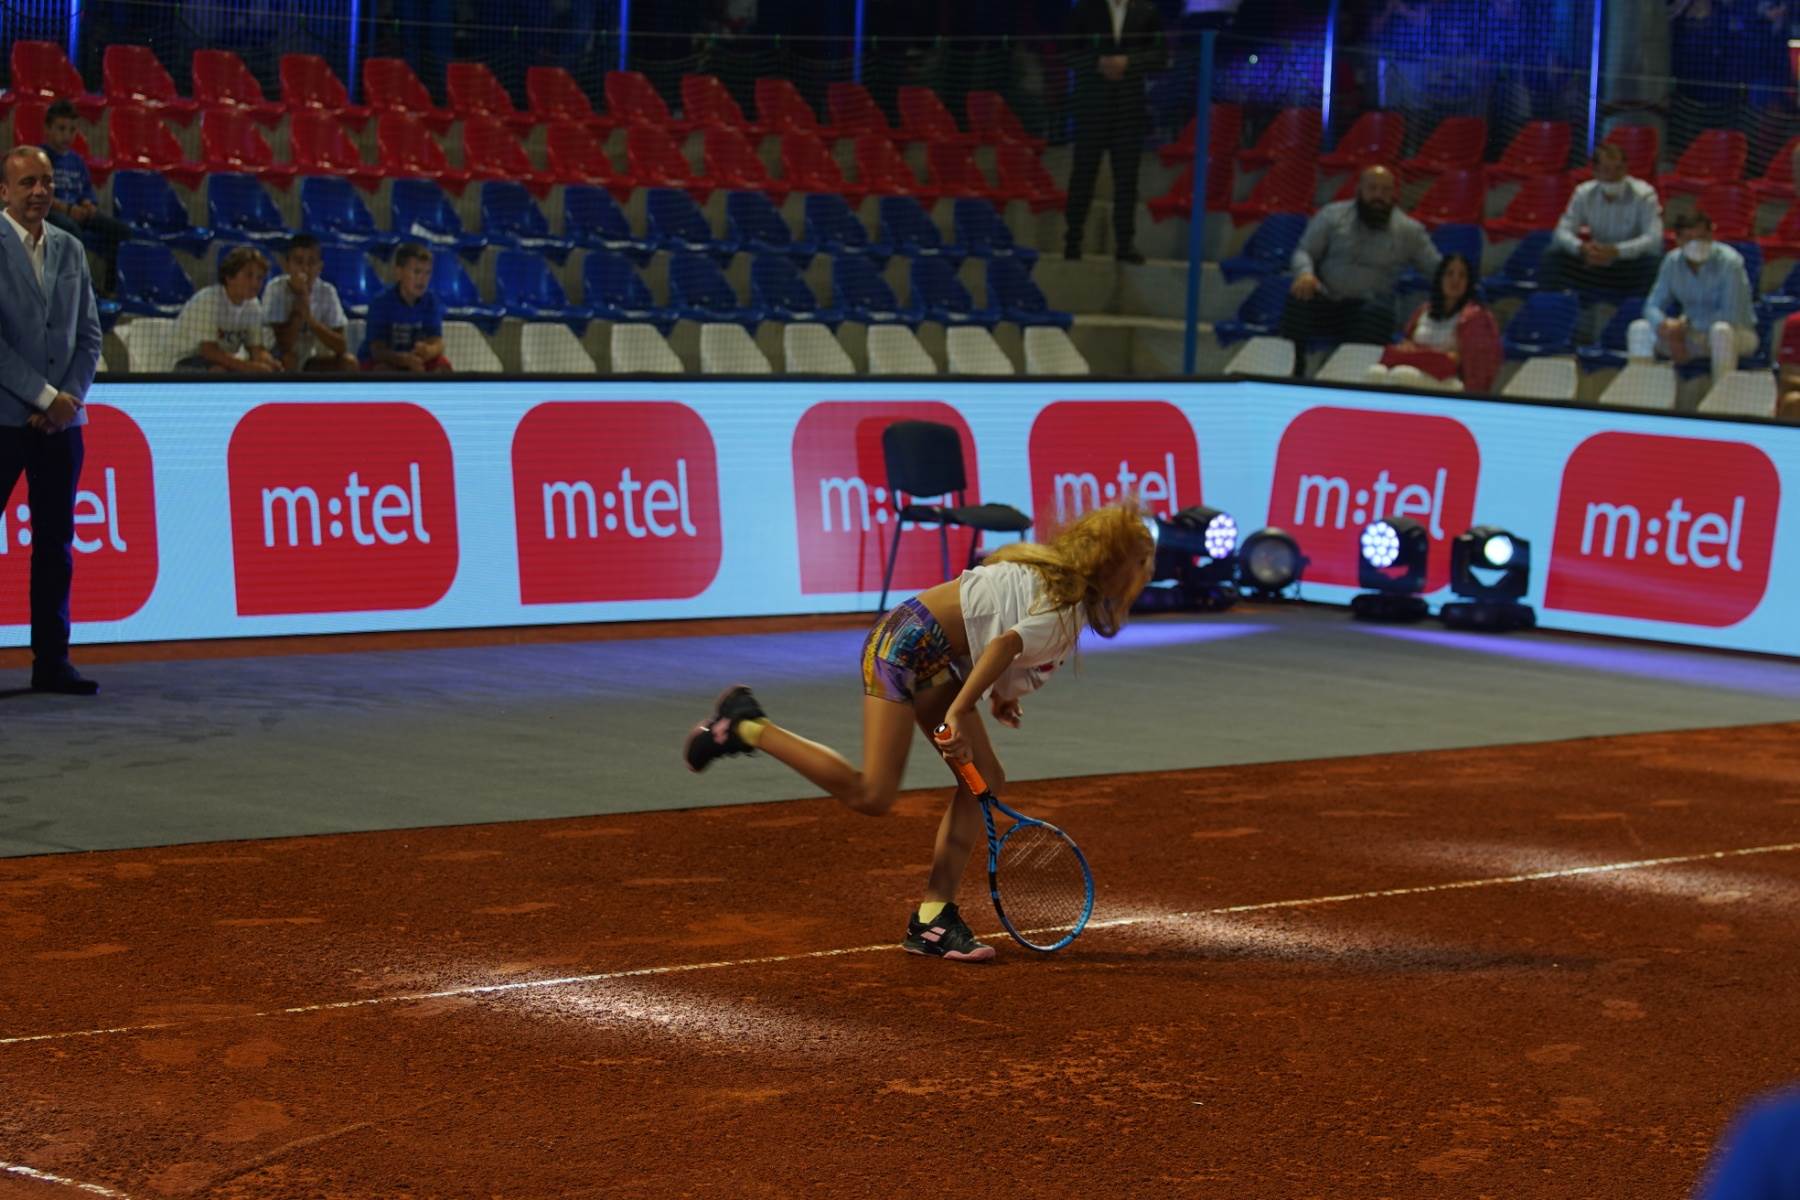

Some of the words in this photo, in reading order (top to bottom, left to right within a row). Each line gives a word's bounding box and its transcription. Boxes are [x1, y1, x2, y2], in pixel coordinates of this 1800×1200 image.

[0, 467, 127, 554] :el
[262, 462, 430, 547] m:tel
[542, 458, 697, 539] m:tel
[1294, 467, 1447, 540] m:tel
[1580, 496, 1745, 571] m:tel
